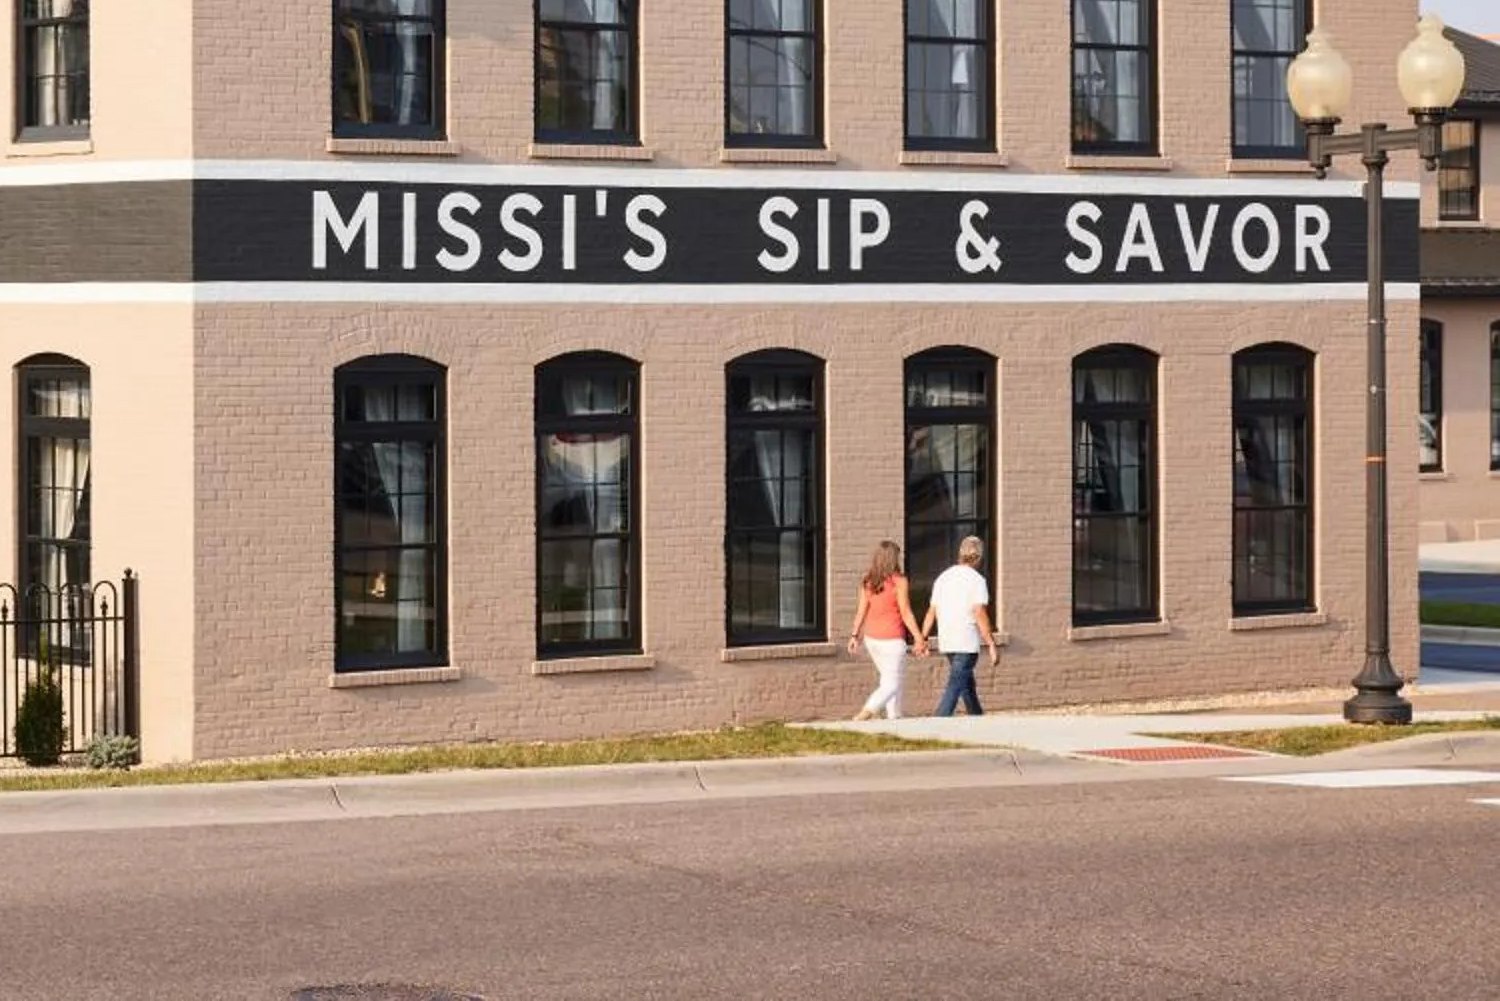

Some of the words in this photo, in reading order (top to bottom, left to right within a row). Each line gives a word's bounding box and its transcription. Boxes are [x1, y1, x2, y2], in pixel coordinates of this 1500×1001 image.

[311, 189, 667, 273] MISSI'S
[757, 196, 891, 272] SIP
[955, 199, 1002, 274] &
[1064, 200, 1331, 274] SAVOR
